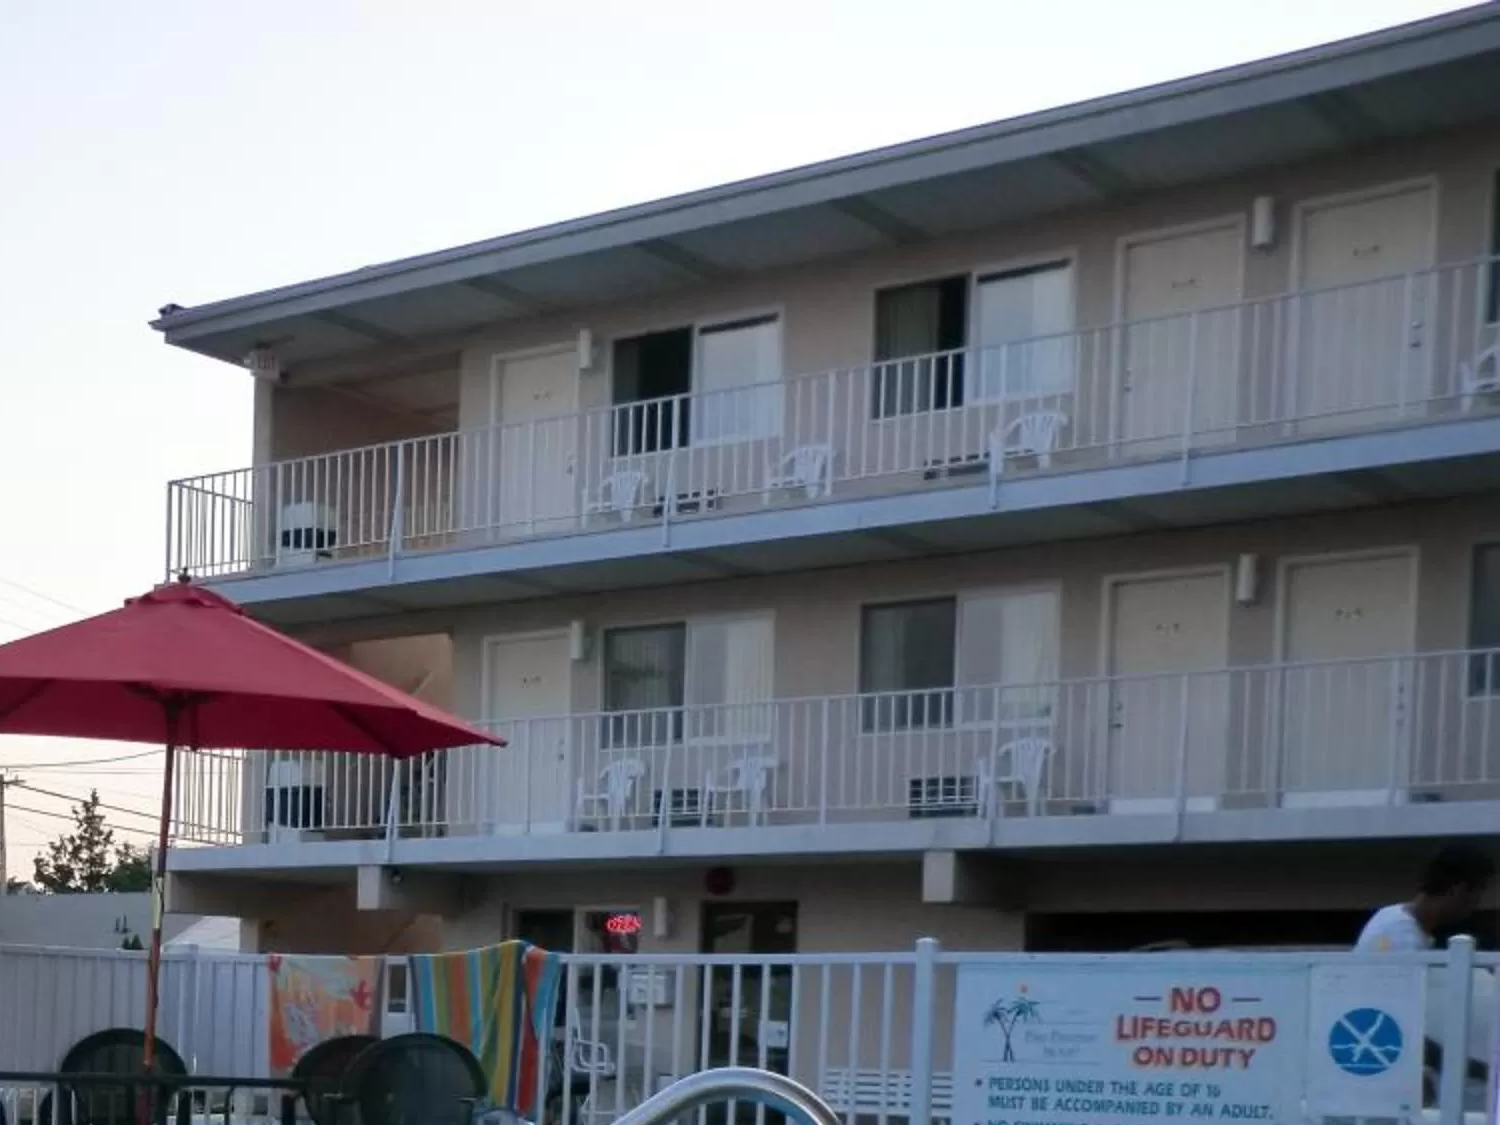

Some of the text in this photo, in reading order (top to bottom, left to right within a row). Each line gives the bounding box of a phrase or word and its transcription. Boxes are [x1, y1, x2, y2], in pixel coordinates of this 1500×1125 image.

[1170, 986, 1221, 1013] NO
[1116, 1014, 1277, 1042] LIFEGUARD
[1133, 1046, 1256, 1069] ON DUTY
[988, 1077, 1049, 1093] PERSONS
[1056, 1079, 1105, 1094] UNDER
[1109, 1080, 1137, 1096] THE
[1144, 1082, 1174, 1097] AGE
[1180, 1083, 1202, 1098] OF
[987, 1095, 1274, 1120] MUST BE ACCOMPANIED BY AN ADULT.
